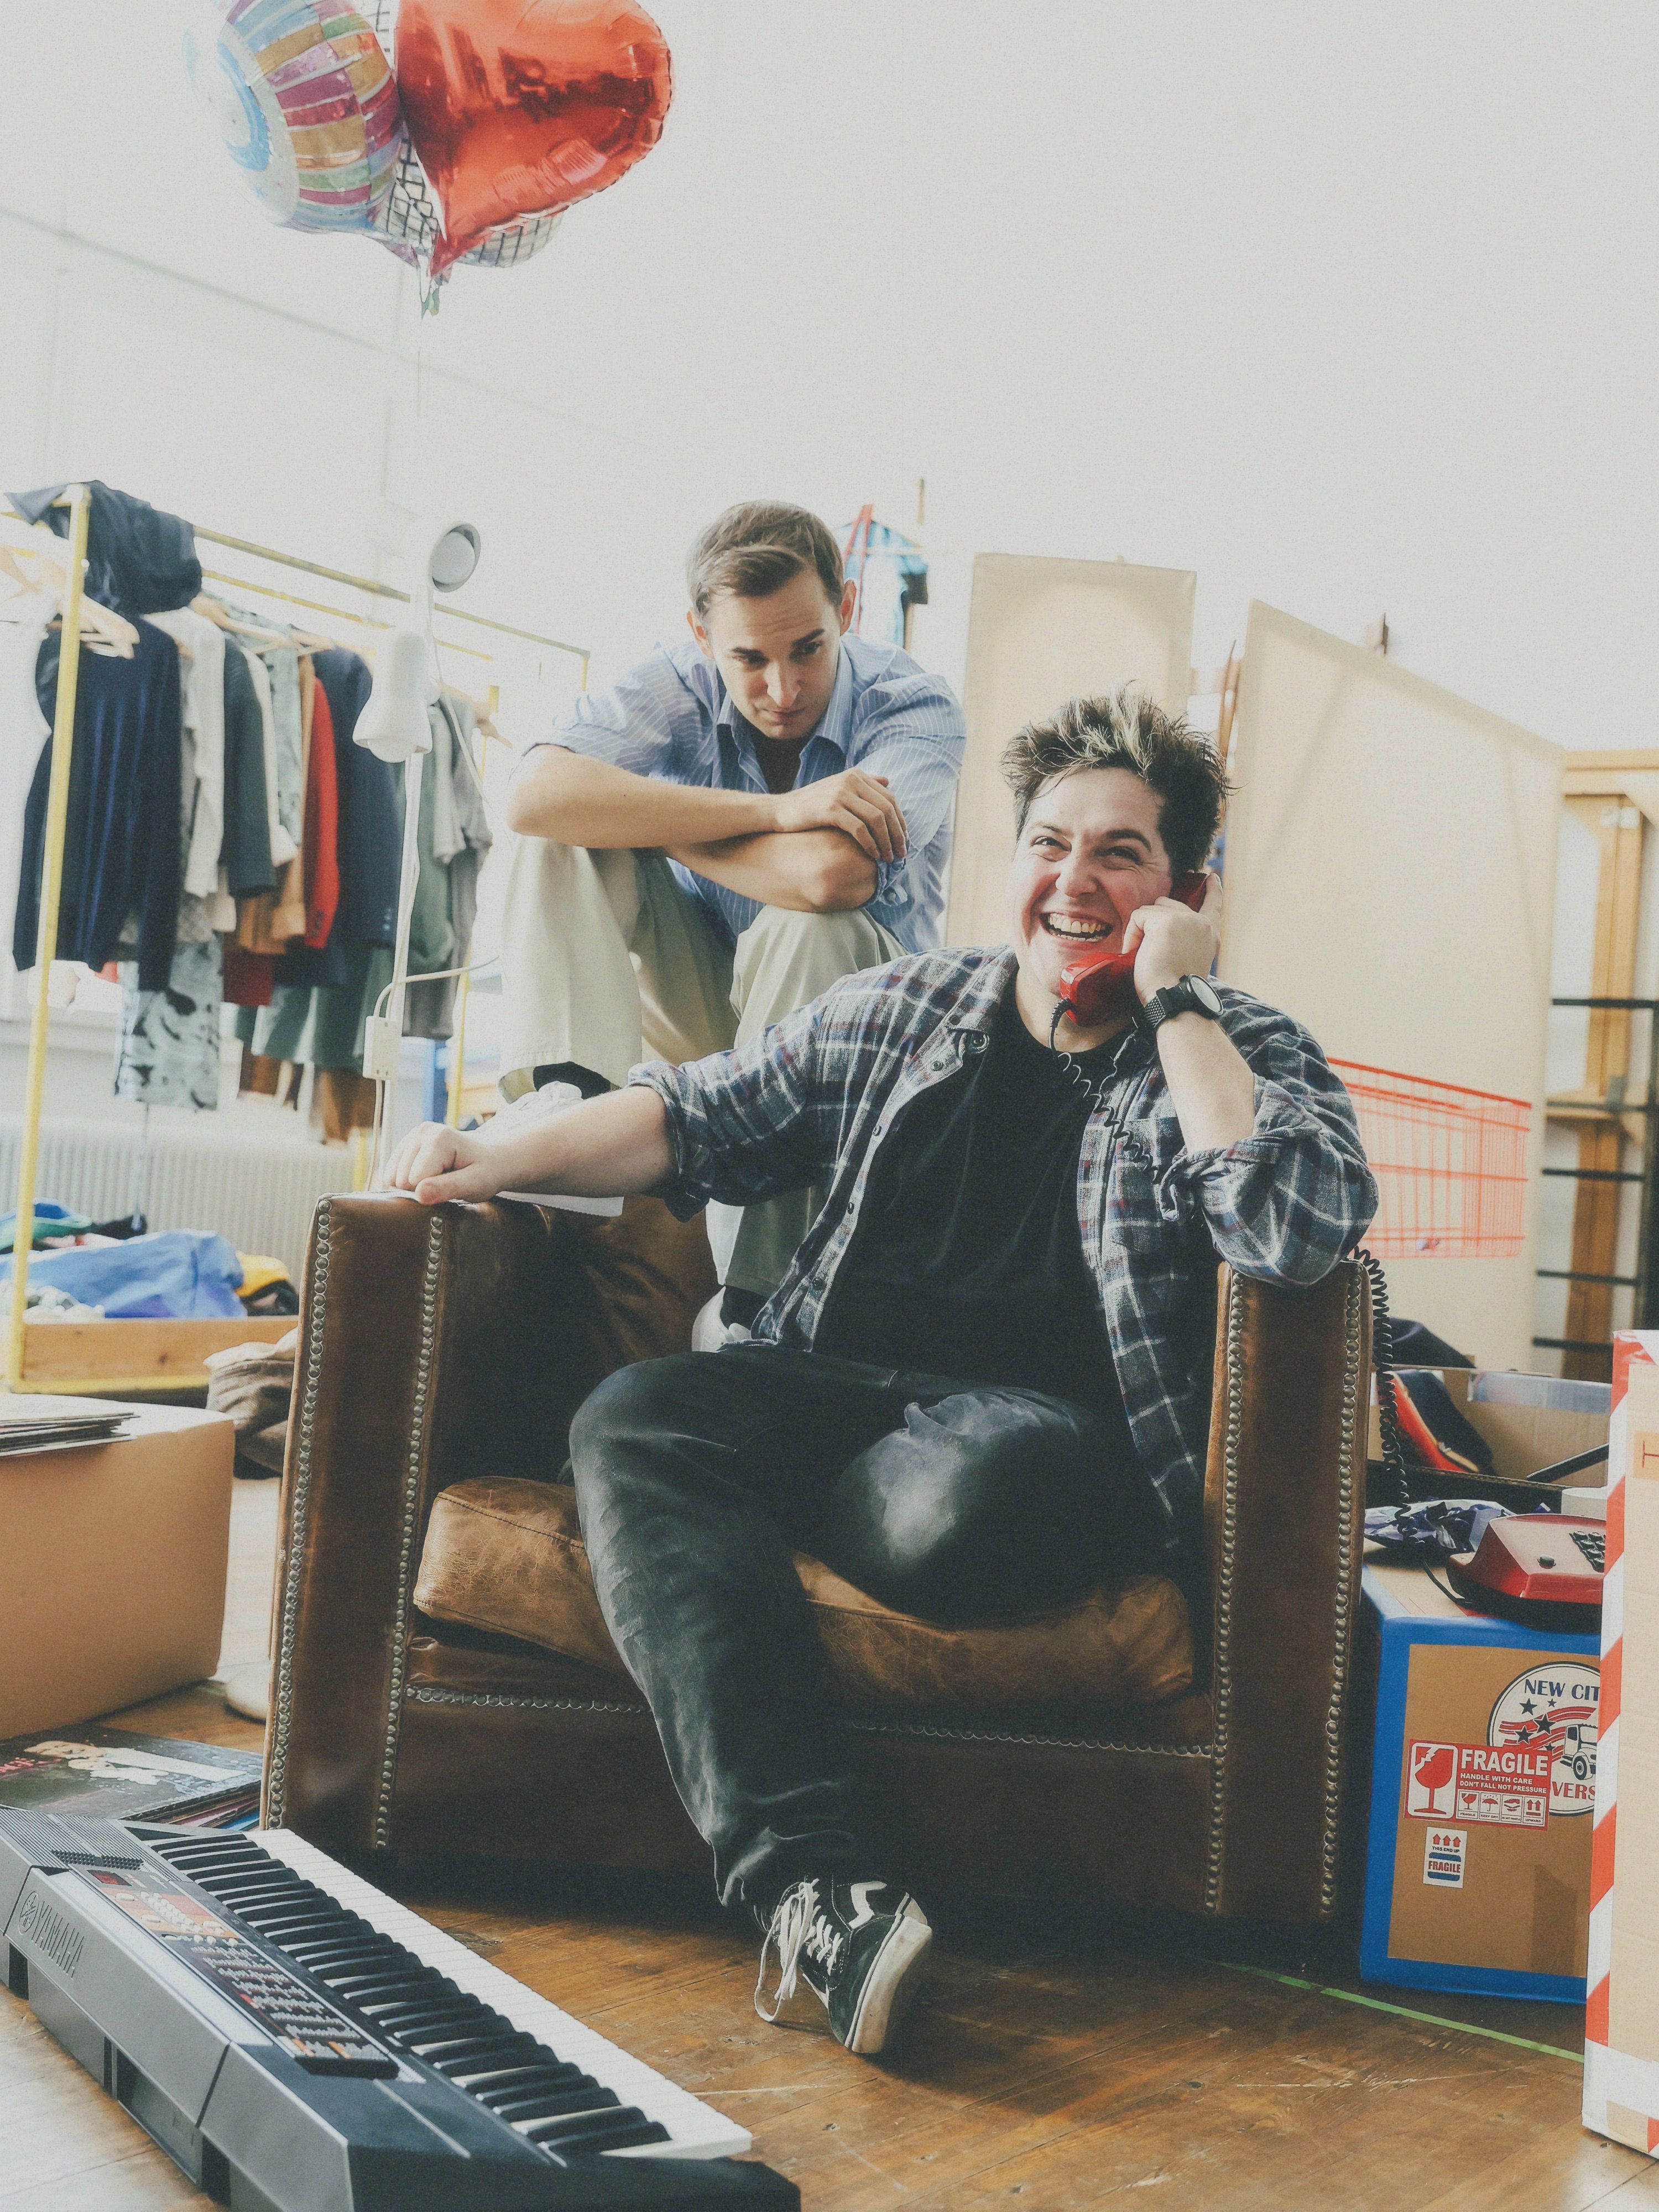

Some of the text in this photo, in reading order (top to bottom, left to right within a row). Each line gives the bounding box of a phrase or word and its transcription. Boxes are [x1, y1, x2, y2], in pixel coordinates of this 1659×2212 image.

[1525, 1679, 1566, 1697] NEW
[1461, 1749, 1548, 1776] FRAGILE
[1513, 1785, 1547, 1793] PRESSURE
[1428, 1860, 1461, 1873] FRAGILE
[31, 1900, 85, 1981] YAMAHA
